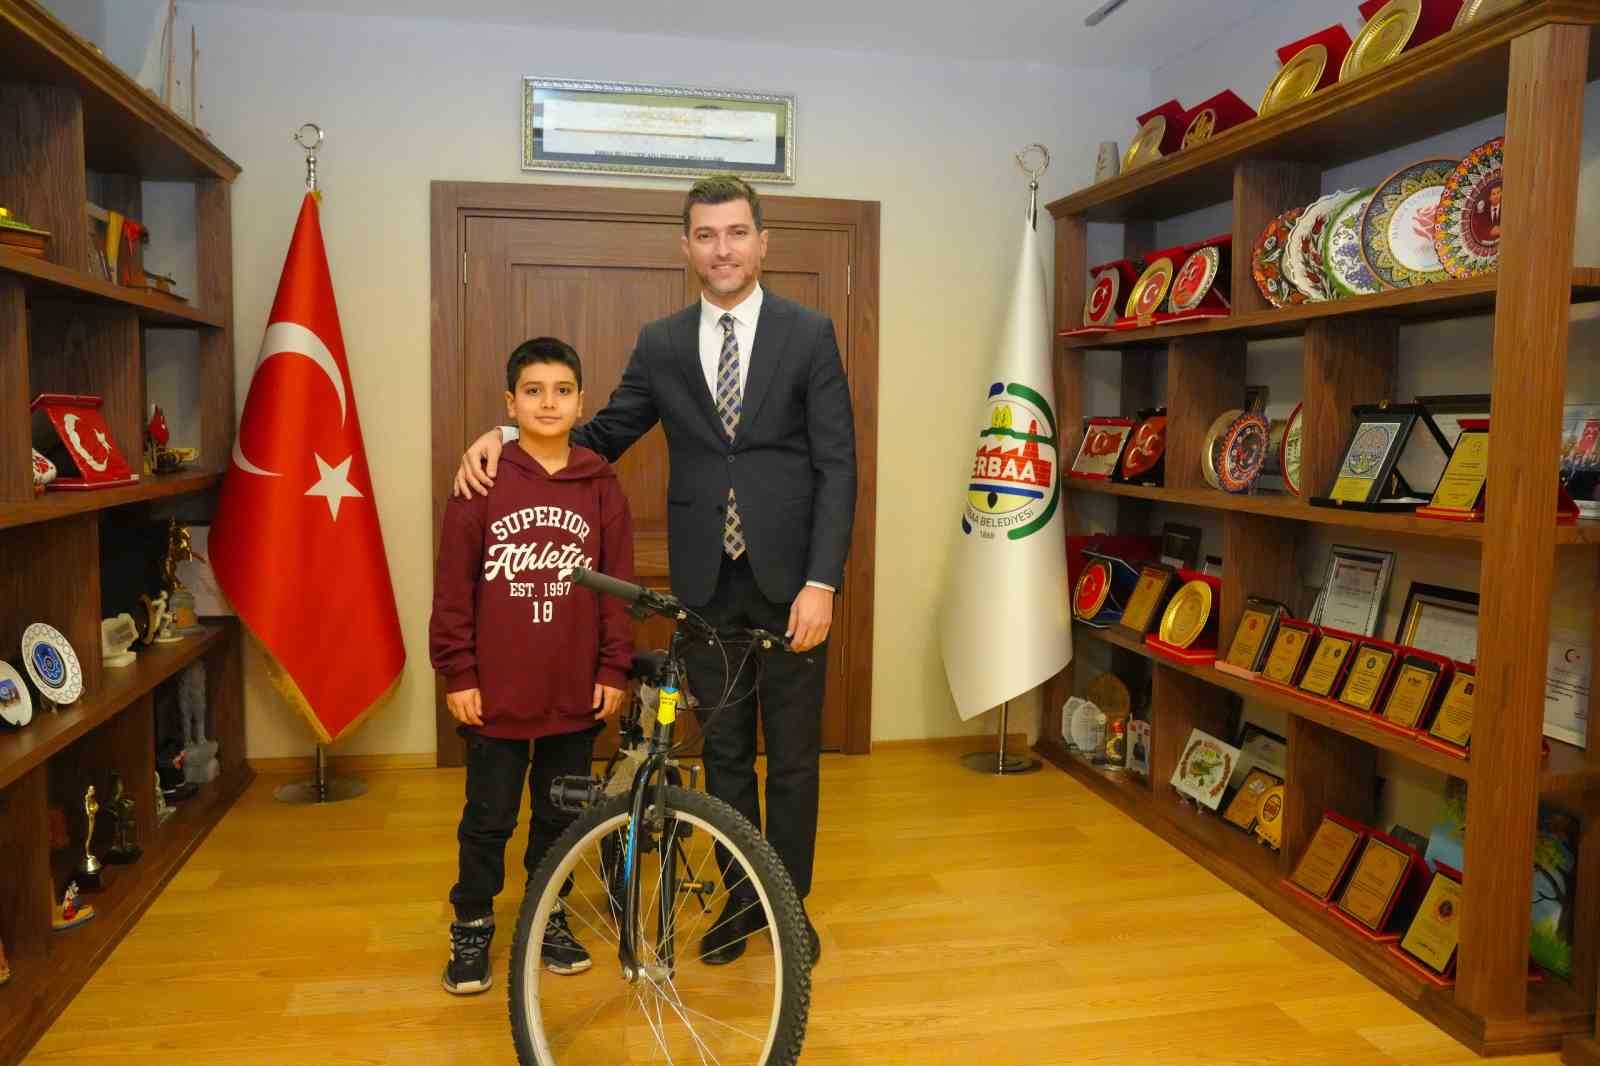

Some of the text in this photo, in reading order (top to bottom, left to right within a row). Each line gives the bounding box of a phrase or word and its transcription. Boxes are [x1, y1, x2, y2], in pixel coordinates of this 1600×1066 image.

[491, 506, 590, 543] SUPERIOR
[509, 582, 571, 598] EST. 1997
[532, 600, 553, 623] 18
